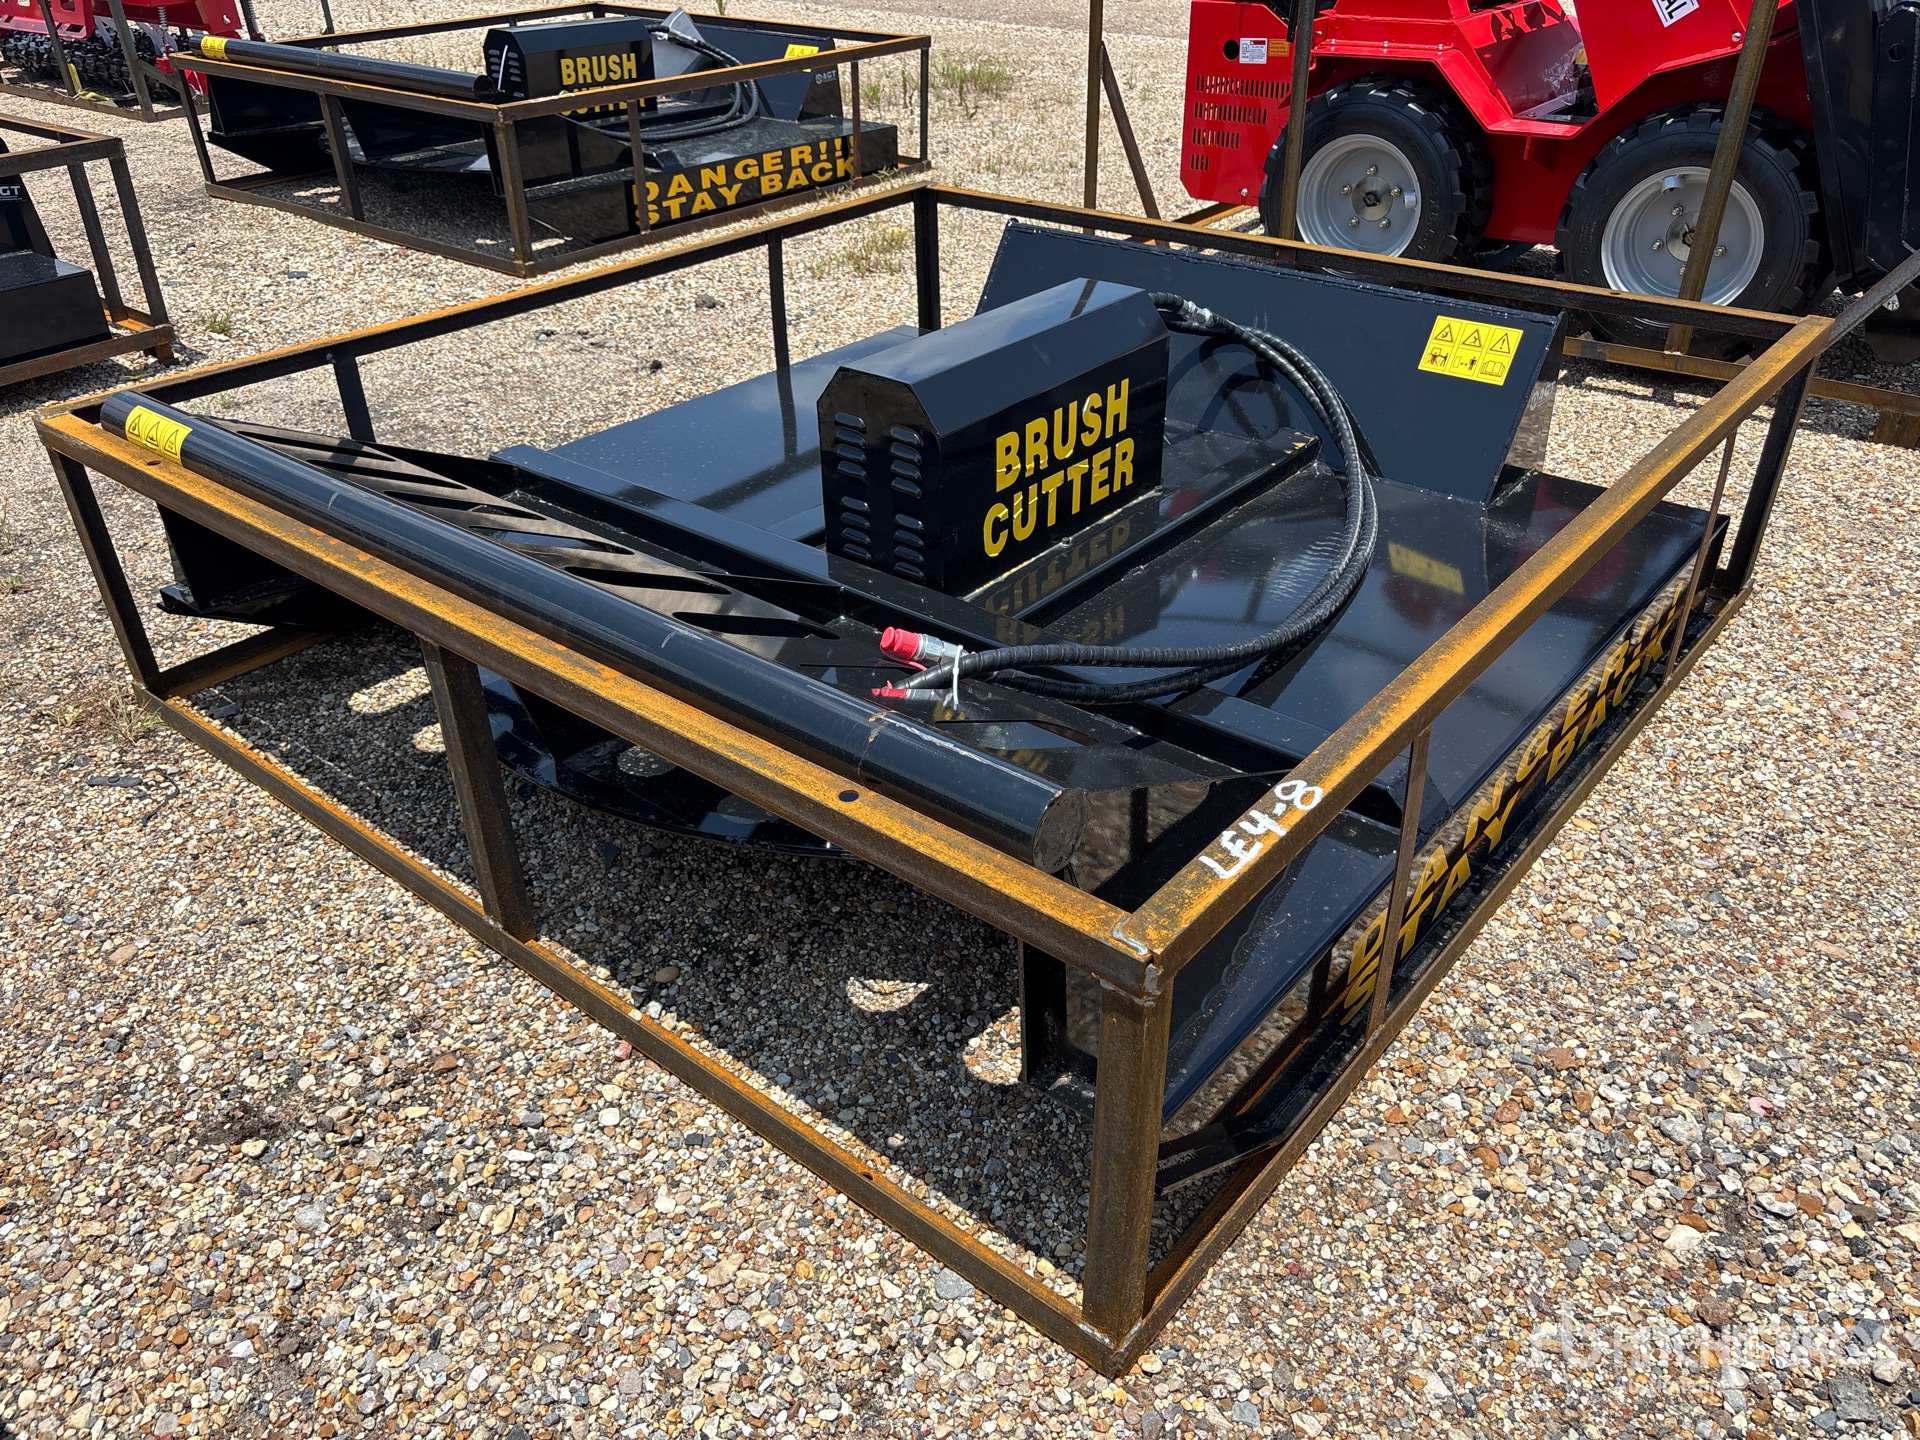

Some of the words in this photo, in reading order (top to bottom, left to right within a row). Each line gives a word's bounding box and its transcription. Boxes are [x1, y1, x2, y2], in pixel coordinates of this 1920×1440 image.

[560, 53, 637, 86] BRUSH
[635, 183, 743, 226] STAY
[761, 157, 855, 196] BACK
[996, 378, 1130, 493] BRUSH
[983, 437, 1135, 558] CUTTER
[1340, 788, 1521, 1026] STAY
[1545, 620, 1673, 786] BACK
